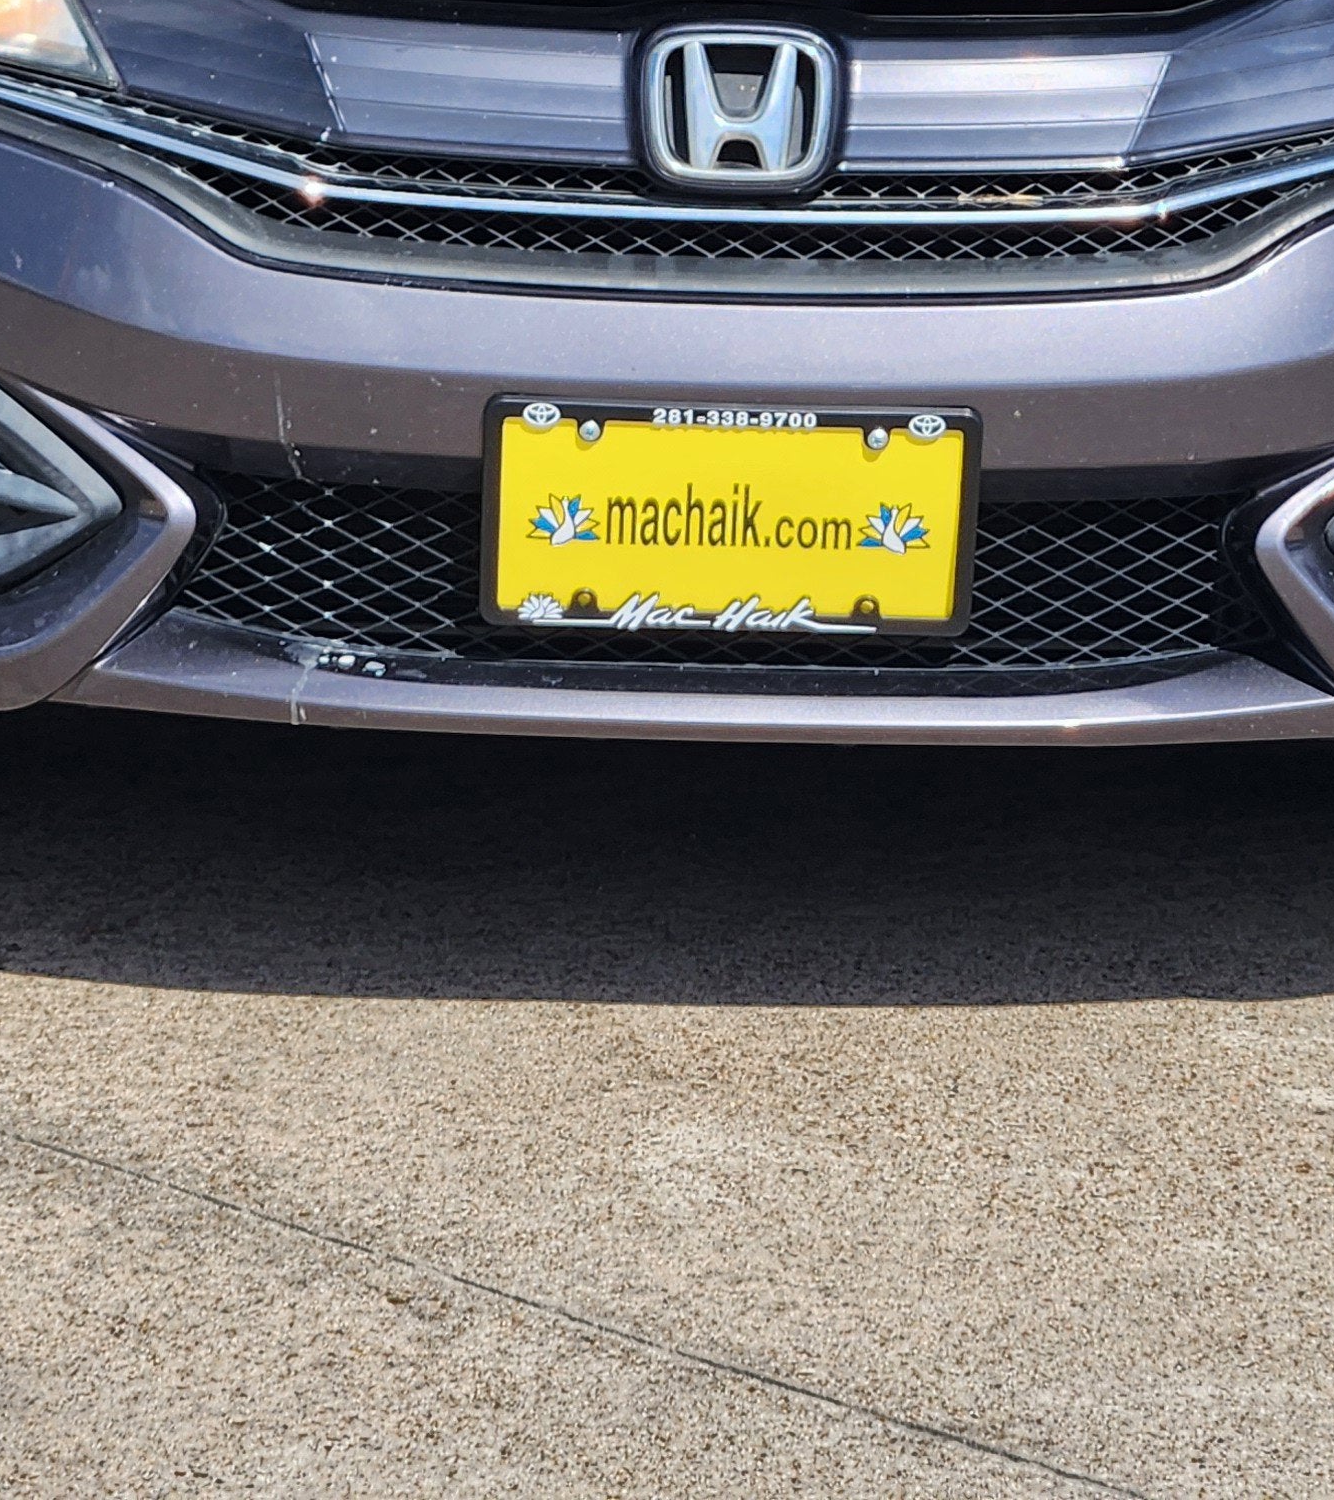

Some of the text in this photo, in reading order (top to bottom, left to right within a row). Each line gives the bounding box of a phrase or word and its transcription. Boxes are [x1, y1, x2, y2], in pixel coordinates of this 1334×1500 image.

[652, 408, 817, 428] 281-338-9700
[605, 482, 852, 549] machaik.com
[610, 591, 816, 632] Mac Haik
